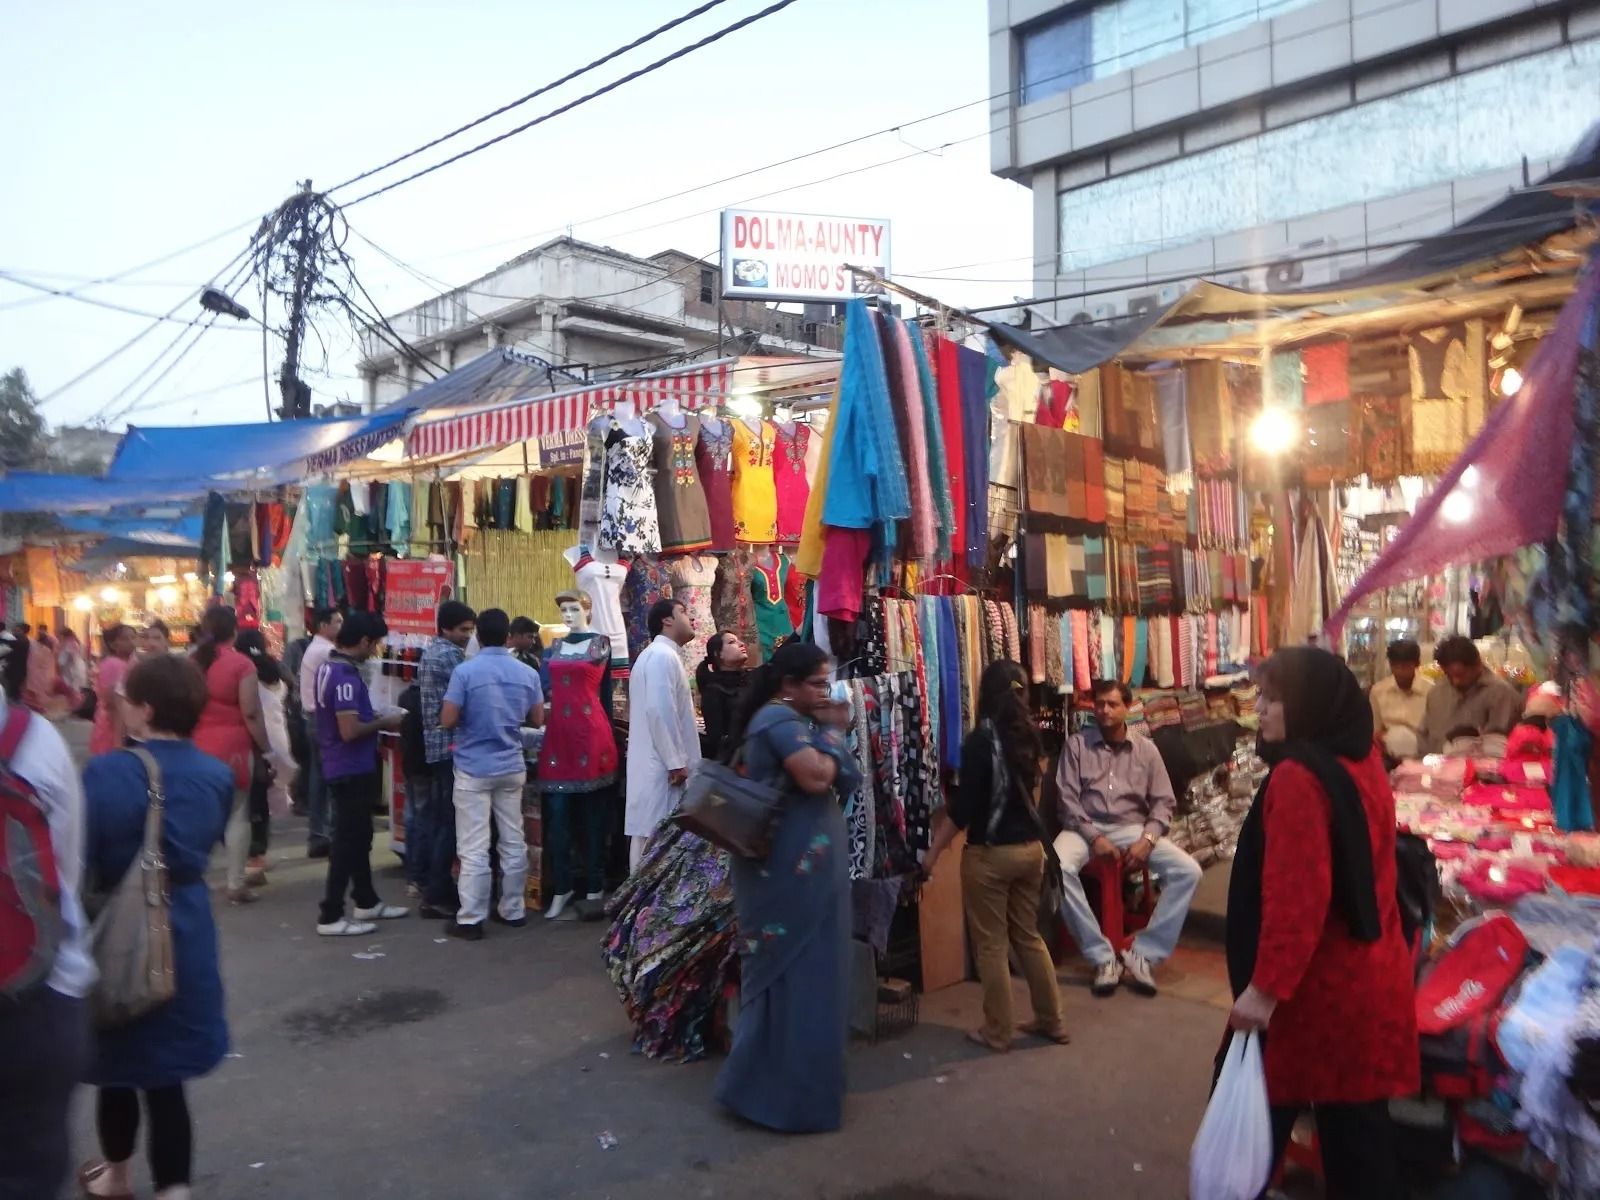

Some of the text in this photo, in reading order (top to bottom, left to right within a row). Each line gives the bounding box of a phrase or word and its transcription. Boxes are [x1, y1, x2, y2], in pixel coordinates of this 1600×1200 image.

[776, 262, 845, 291] MOMO'S
[541, 429, 586, 450] VERMA DRESS
[336, 683, 353, 702] 10
